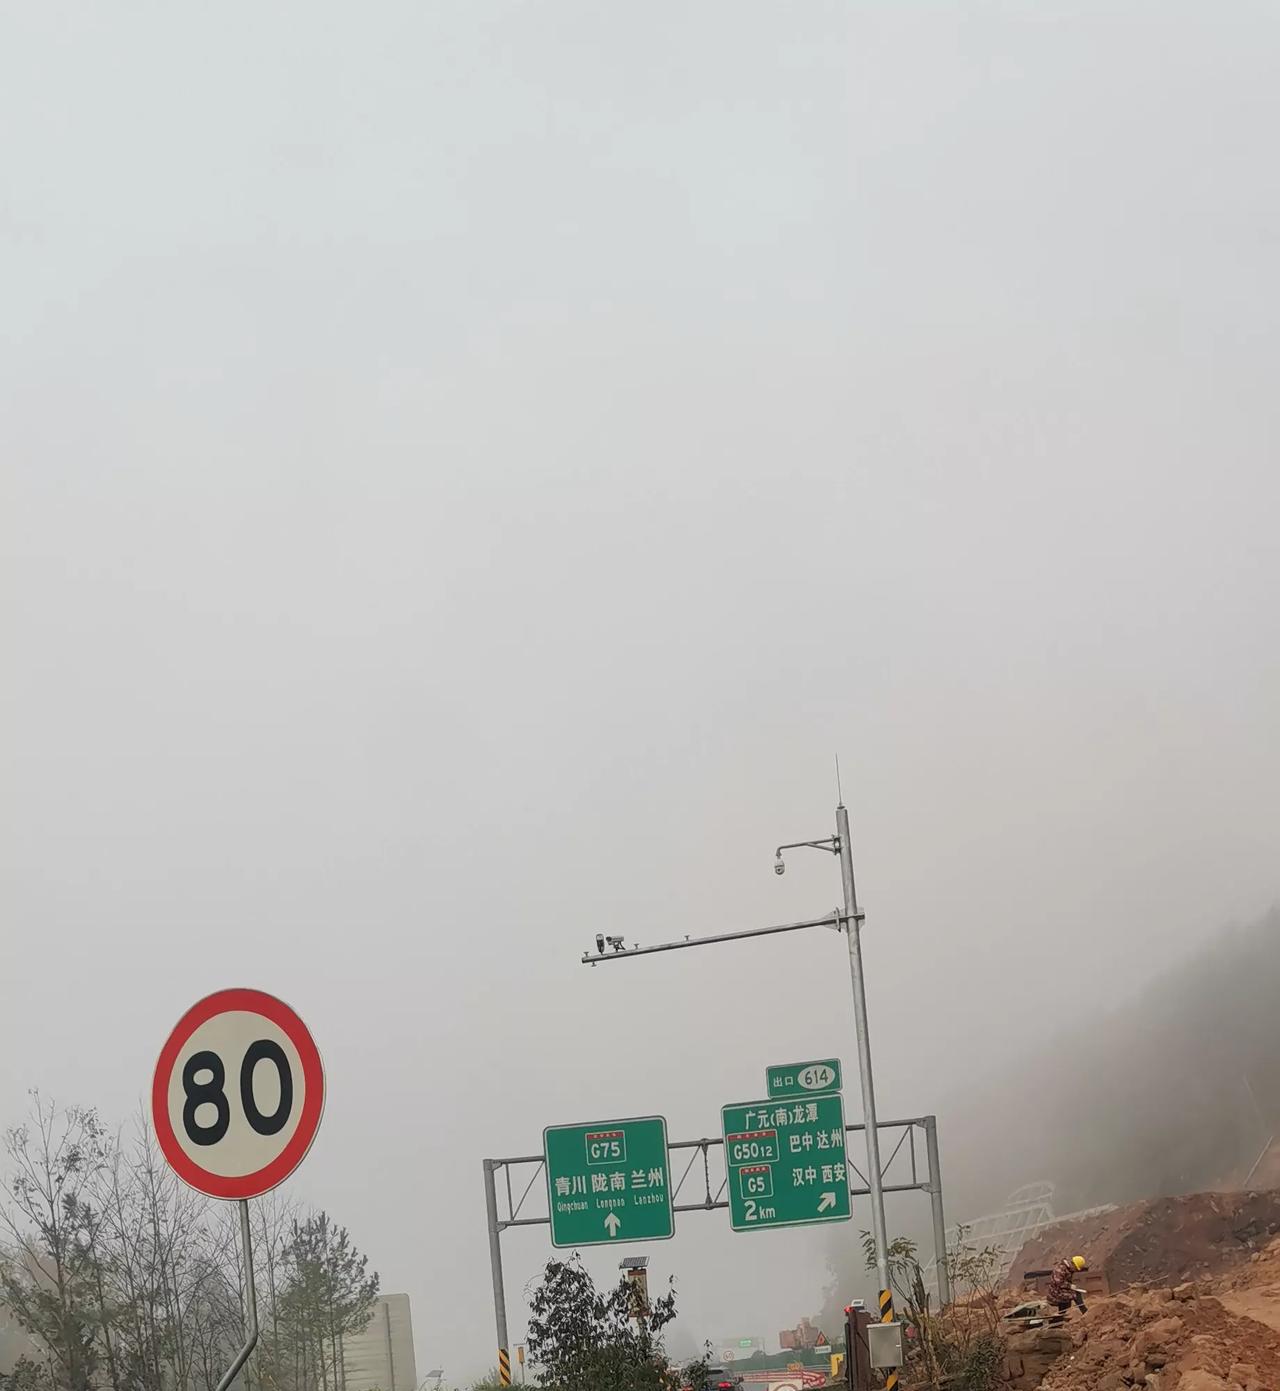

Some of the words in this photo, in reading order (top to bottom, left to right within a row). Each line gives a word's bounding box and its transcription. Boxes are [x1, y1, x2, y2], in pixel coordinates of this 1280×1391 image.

[773, 1076, 794, 1088] 出口
[804, 1069, 829, 1086] 614
[182, 1039, 293, 1146] 80
[789, 1131, 814, 1153] 巴中
[816, 1127, 843, 1150] 达州
[591, 1142, 621, 1159] G75
[733, 1142, 773, 1160] G5012
[555, 1175, 587, 1197] 青川
[591, 1171, 626, 1193] 陇南
[631, 1167, 664, 1189] 兰州
[792, 1165, 817, 1187] 汉中
[821, 1162, 846, 1184] 西安
[748, 1176, 766, 1193] G5
[634, 1193, 664, 1206] Lanzhou
